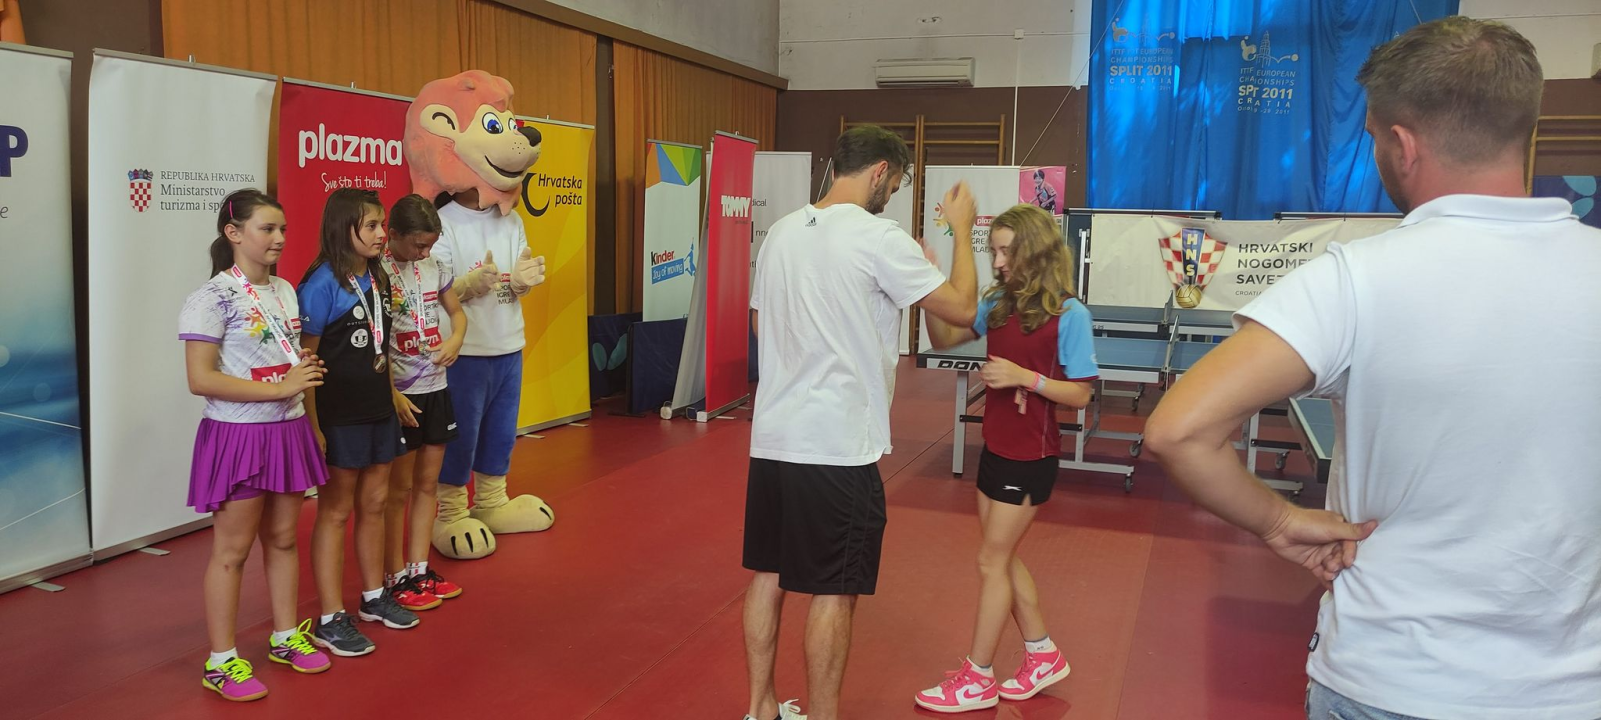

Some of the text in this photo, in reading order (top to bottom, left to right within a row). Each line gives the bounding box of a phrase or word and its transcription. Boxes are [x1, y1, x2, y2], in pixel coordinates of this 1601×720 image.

[1110, 64, 1172, 76] SPLIT 2011
[1256, 69, 1296, 77] EUROPEAN
[1109, 77, 1172, 85] CROATIA
[1261, 87, 1293, 99] 2011
[298, 122, 403, 168] plazma
[160, 170, 256, 183] REPUBLIKA HRVATSKA
[321, 170, 387, 192] Sve što ti treba!
[537, 173, 582, 189] Hrvatska
[160, 183, 226, 197] Ministarstvo
[160, 199, 200, 211] turizma
[202, 199, 206, 210] i
[554, 192, 582, 208] pošta
[721, 195, 751, 218] TOMMY
[1238, 242, 1313, 254] HRVATSKI
[667, 262, 684, 275] moving
[1237, 258, 1311, 269] NOGOME
[1236, 274, 1285, 285] SAVE
